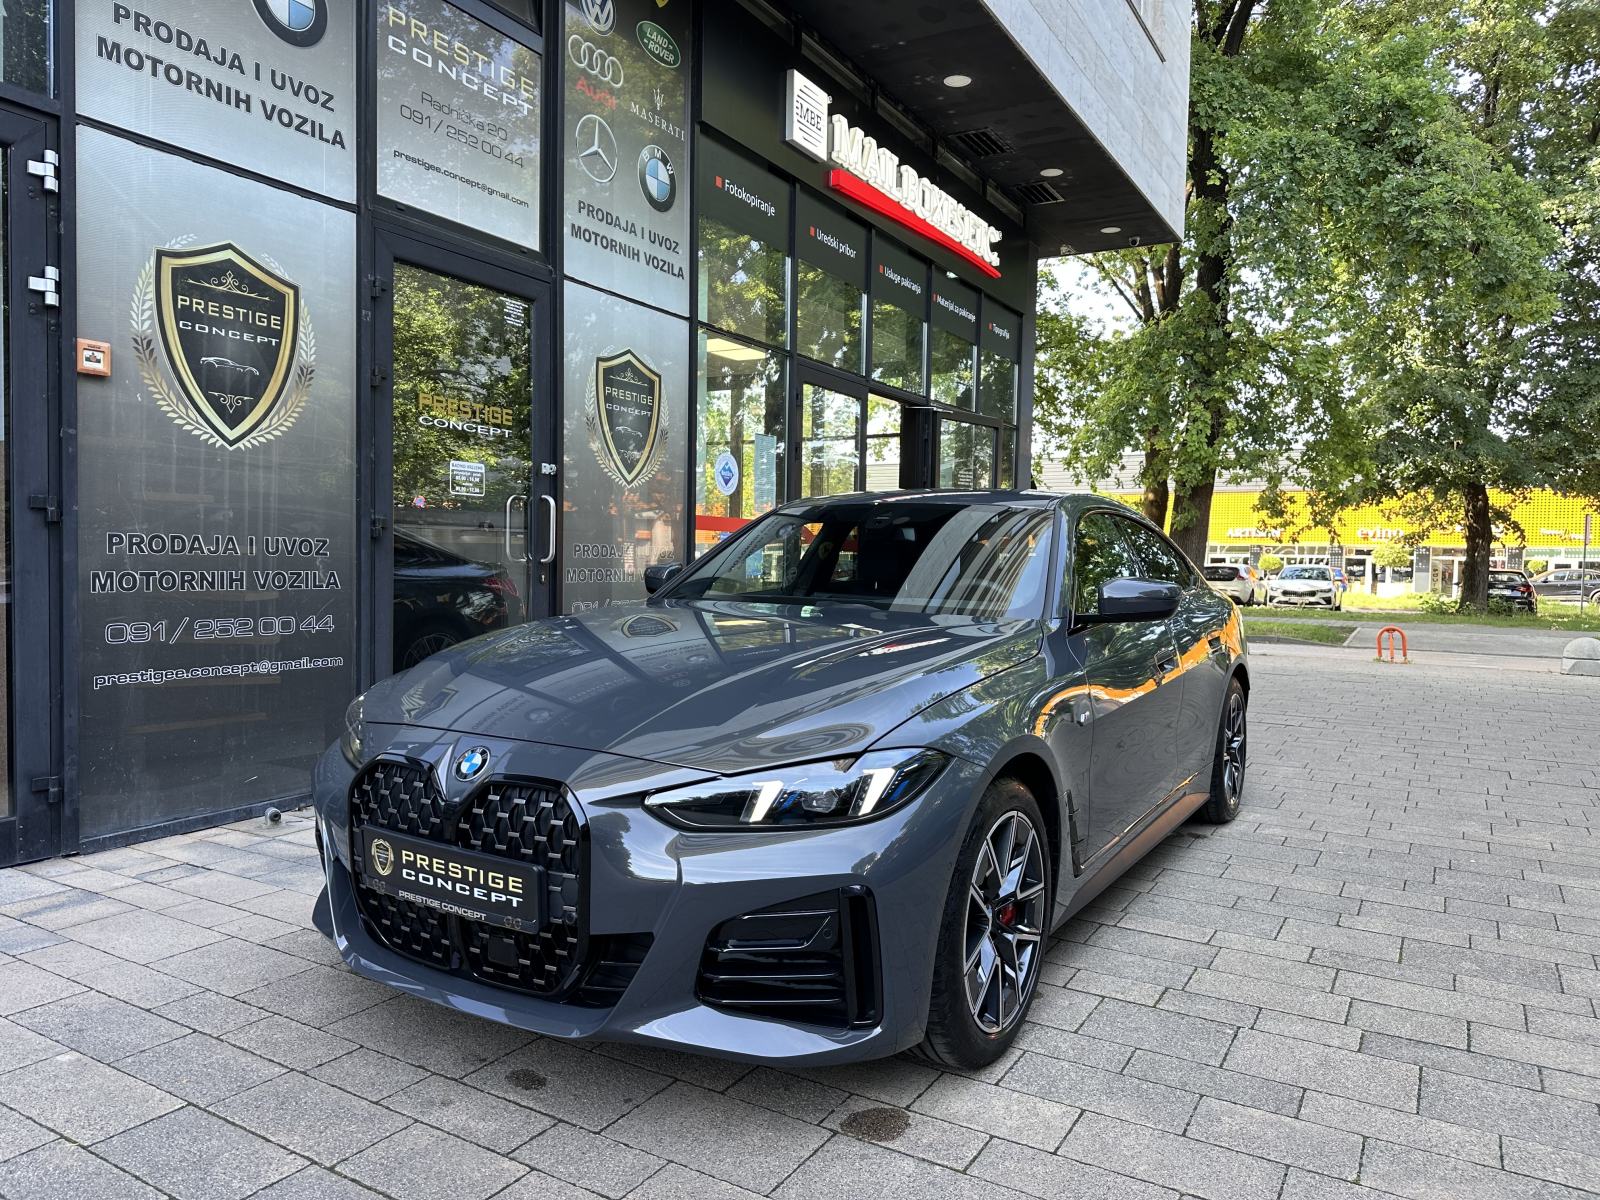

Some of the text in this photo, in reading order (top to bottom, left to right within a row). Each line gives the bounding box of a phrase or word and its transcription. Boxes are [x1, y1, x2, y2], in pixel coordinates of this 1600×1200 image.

[113, 2, 335, 112] PRODAJA I UVOZ
[388, 6, 534, 100] PRESTIGE
[96, 34, 346, 150] MOTORNIH VOZILA
[387, 34, 534, 116] CONCEPT
[421, 91, 508, 142] Radnička 20
[630, 101, 685, 142] MASERATI
[799, 102, 822, 132] MBE
[504, 152, 524, 168] 44
[642, 147, 674, 175] BMW
[393, 150, 529, 208] prestigee.concept@gmail.com
[831, 114, 900, 203] MAIL
[900, 165, 965, 243] BOXES
[724, 179, 776, 216] Fotokopiranje
[578, 200, 680, 254] PRODAJA I UVOZ
[816, 228, 857, 259] Uredski pribor
[571, 222, 685, 280] MOTORNIH VOZILA
[884, 265, 900, 284] Usluge
[178, 295, 281, 330] PRESTIGE
[179, 320, 280, 346] CONCEPT
[418, 392, 513, 426] PRESTIGE
[605, 386, 653, 405] PRESTIGE
[606, 403, 652, 417] CONCEPT
[418, 416, 513, 438] CONCEPT
[106, 532, 330, 558] PRODAJA I UVOZ
[573, 542, 635, 559] PRODAJA
[90, 570, 341, 593] MOTORNIH VOZILA
[565, 568, 637, 584] MOTORNIH
[300, 615, 335, 633] 44
[93, 655, 344, 689] prestigee.concept@gmail.com
[401, 849, 523, 894] PRESTIGE
[402, 868, 523, 907] CONCEPT
[398, 889, 487, 921] PRESTIGE CONCEPT
